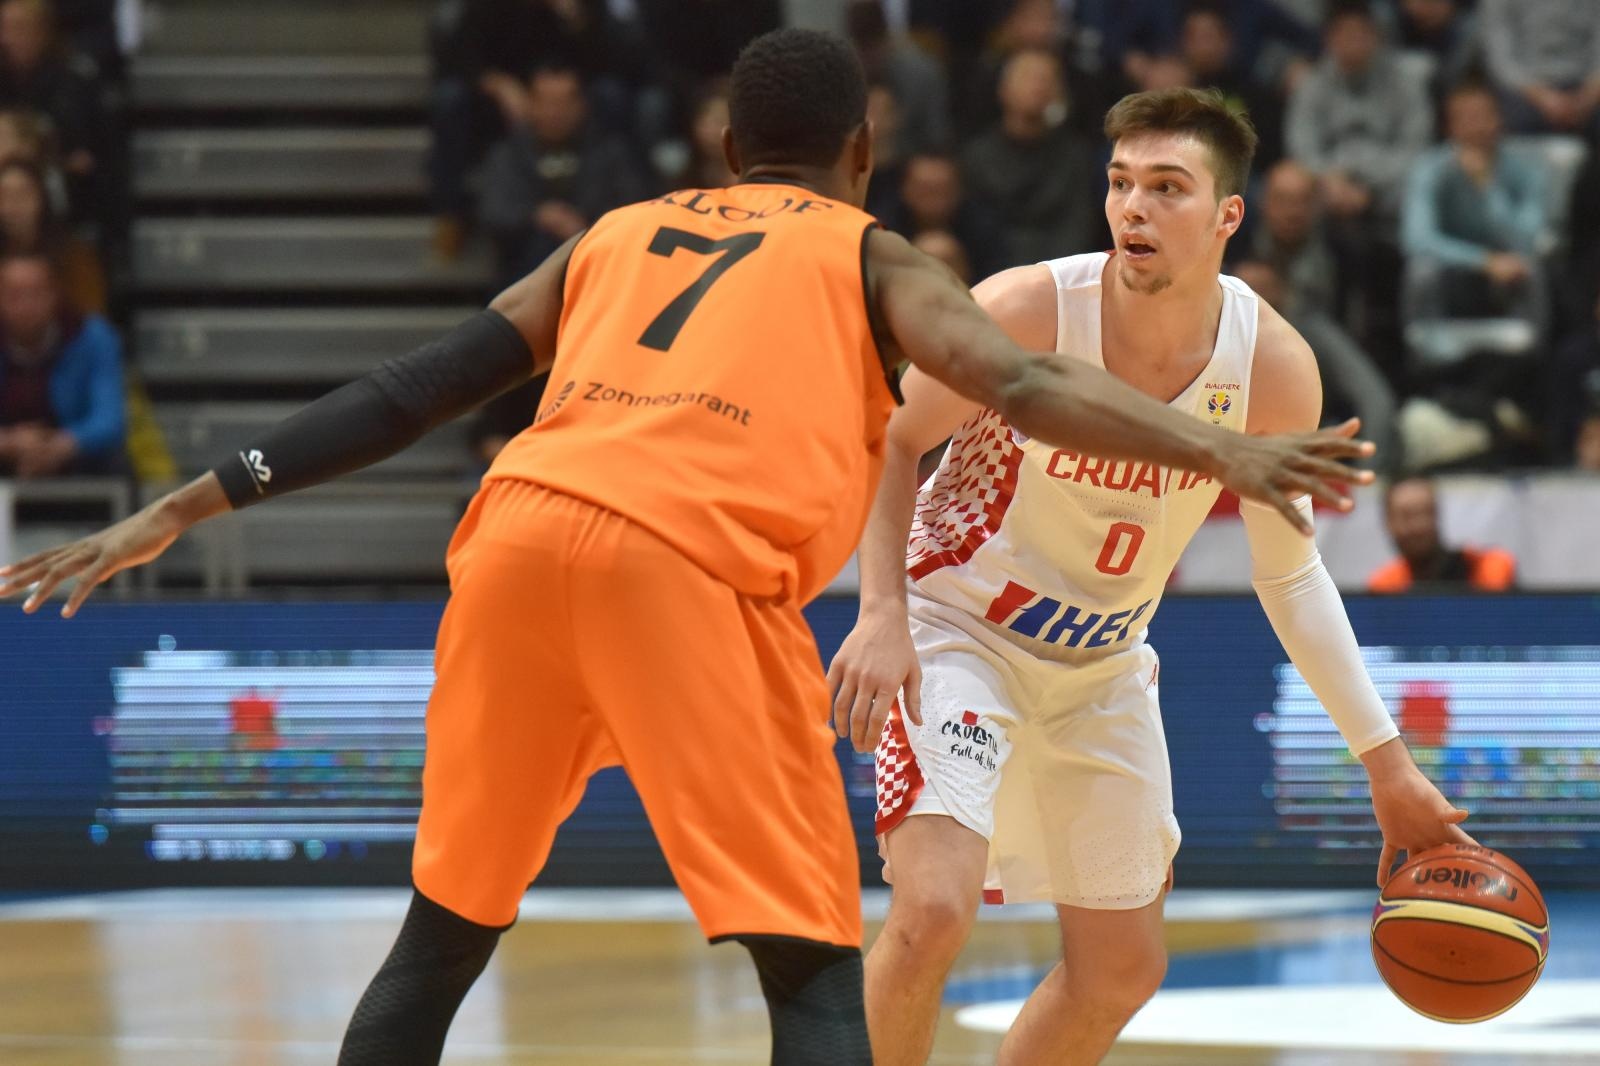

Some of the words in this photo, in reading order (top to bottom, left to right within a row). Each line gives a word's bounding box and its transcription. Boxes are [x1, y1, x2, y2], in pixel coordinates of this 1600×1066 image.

[636, 226, 766, 352] 7
[583, 381, 752, 426] Zonnegarant
[1094, 521, 1146, 576] 0
[1042, 598, 1153, 648] HEP
[941, 720, 998, 755] CROATIA
